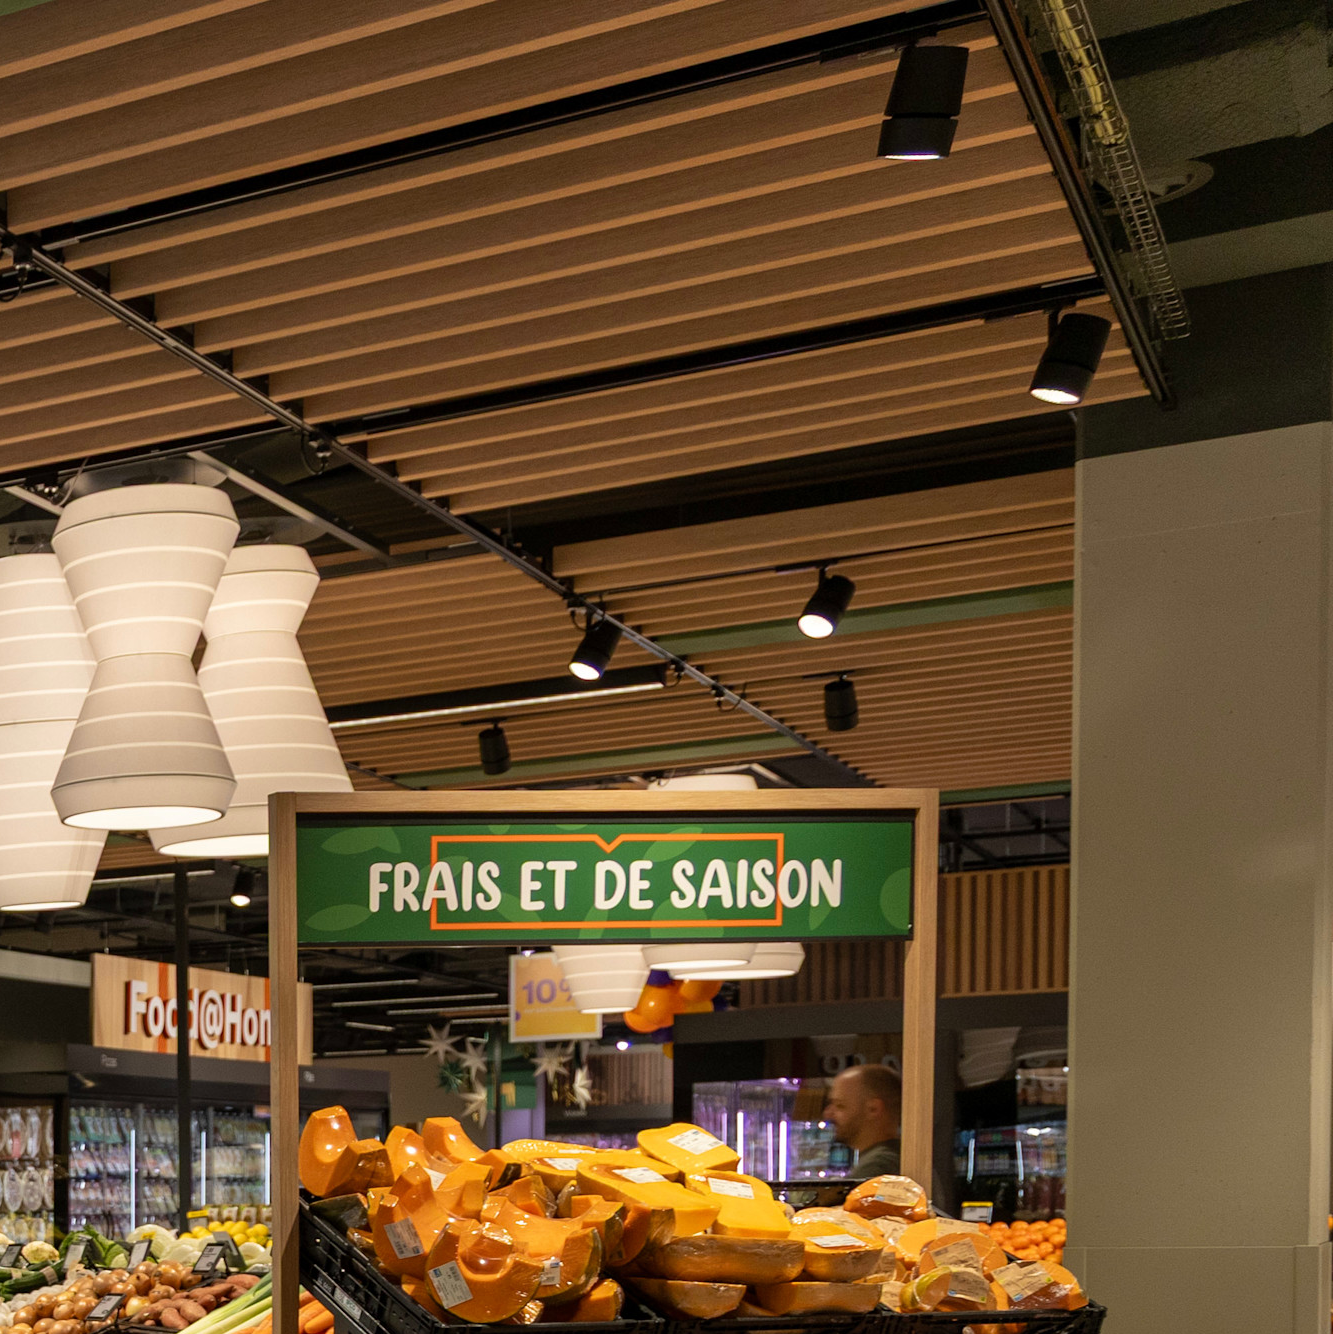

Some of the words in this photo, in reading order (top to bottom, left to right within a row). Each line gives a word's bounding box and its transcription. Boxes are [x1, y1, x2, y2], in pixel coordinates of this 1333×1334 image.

[368, 860, 502, 914] FRAIS
[519, 859, 578, 912] ET
[593, 859, 655, 911] DE
[669, 858, 843, 910] SAISON
[125, 979, 271, 1049] Food@Ho
